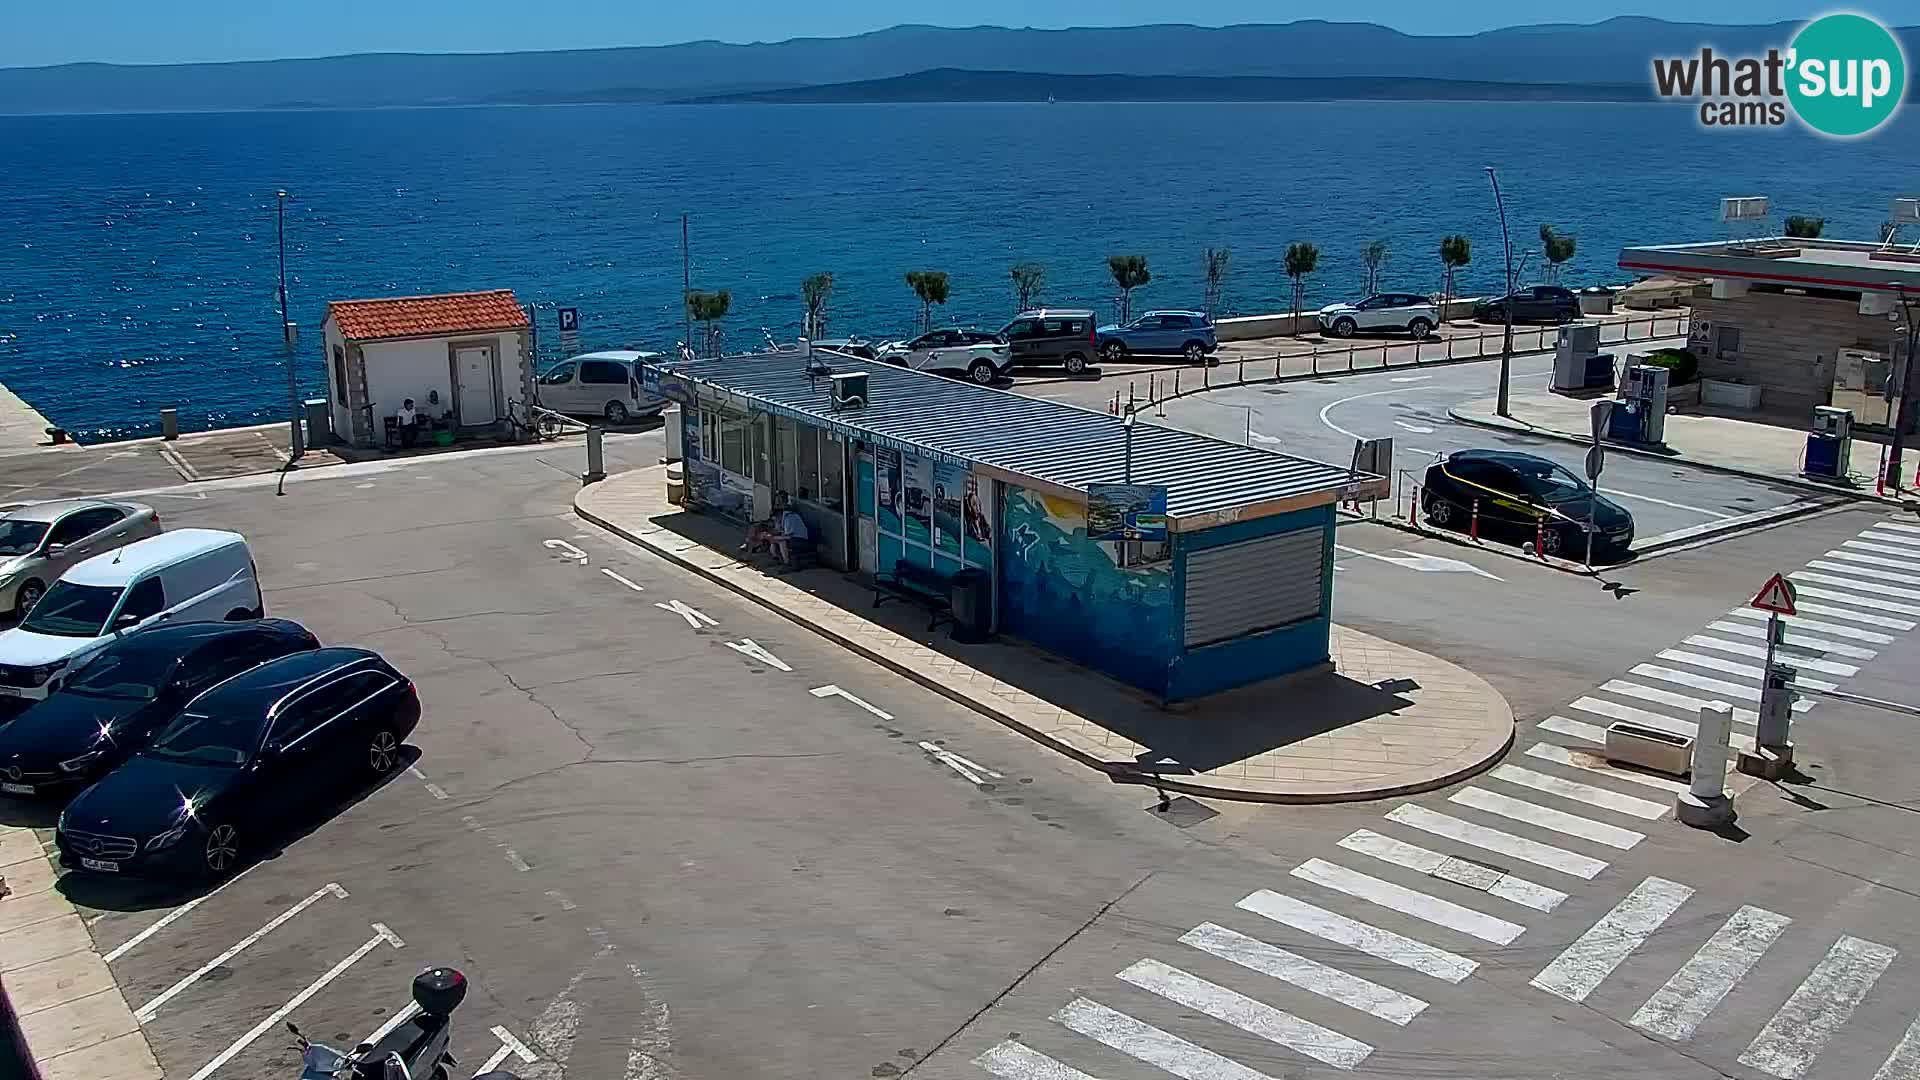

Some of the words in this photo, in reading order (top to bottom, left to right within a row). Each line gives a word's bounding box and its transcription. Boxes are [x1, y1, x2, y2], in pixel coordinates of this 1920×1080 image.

[562, 311, 574, 329] P
[870, 433, 884, 446] BUS
[885, 438, 916, 454] STATION
[918, 447, 942, 462] TICKET
[943, 454, 969, 469] OFFICE
